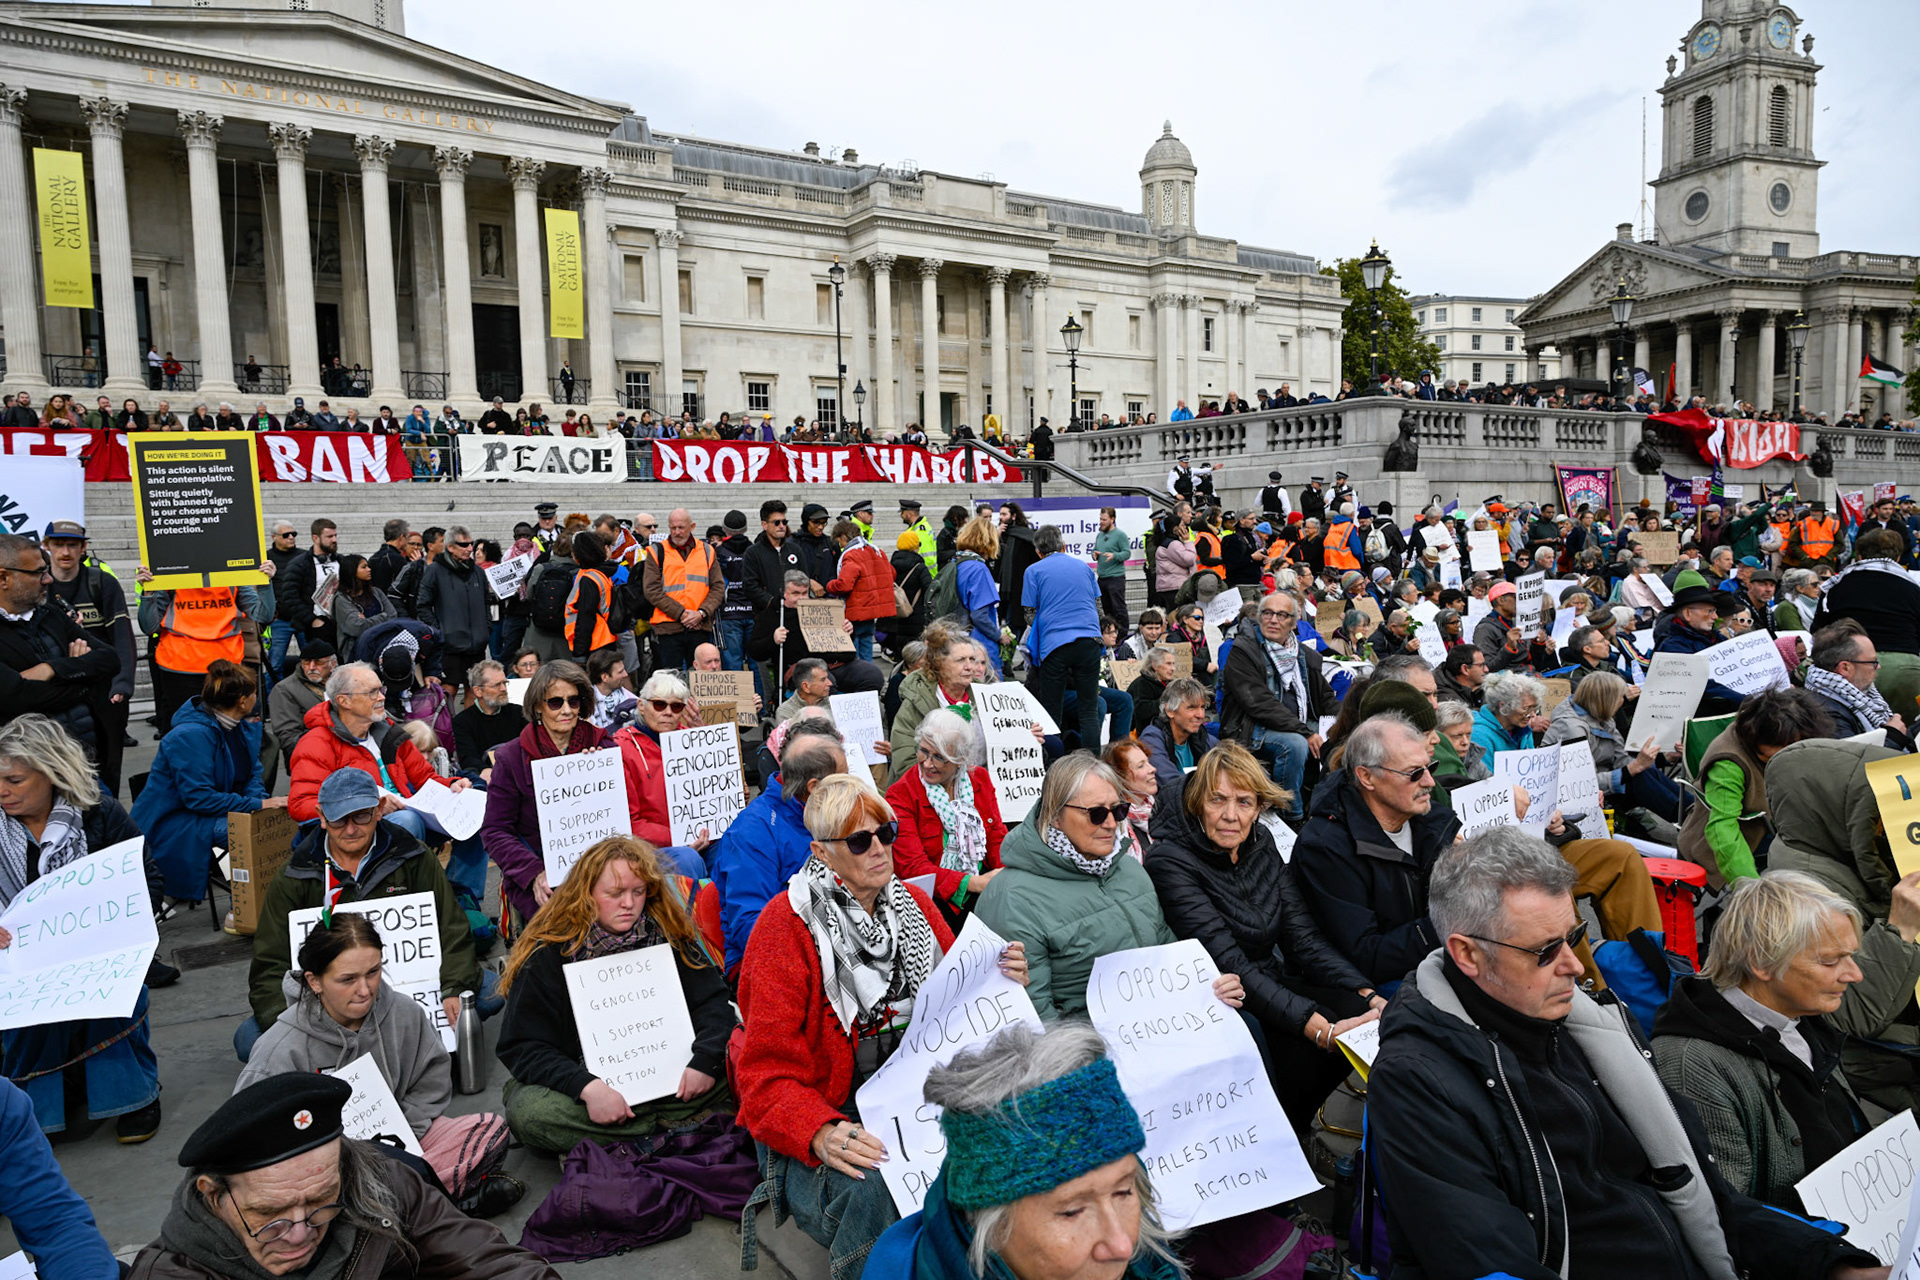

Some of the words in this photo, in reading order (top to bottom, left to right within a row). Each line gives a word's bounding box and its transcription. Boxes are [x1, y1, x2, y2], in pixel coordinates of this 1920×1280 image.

[142, 68, 200, 89] THE
[221, 79, 367, 114] NATIONAL
[384, 105, 495, 133] GALLERY
[49, 175, 65, 248] NATIONAL
[63, 176, 82, 249] GALLERY
[556, 231, 567, 290] NATIONAL
[565, 232, 578, 291] GALLERY
[146, 467, 166, 475] This
[168, 466, 196, 474] action
[209, 465, 234, 473] silent
[263, 435, 391, 483] BAN
[483, 442, 612, 474] PEACE
[654, 440, 770, 483] DROP
[779, 444, 850, 483] THE
[167, 475, 235, 484] contemplative.
[149, 490, 180, 498] Sitting
[181, 488, 213, 498] quietly
[150, 499, 171, 507] with
[173, 498, 207, 506] banned
[209, 497, 233, 505] signs
[164, 518, 200, 526] courage
[202, 515, 219, 523] and
[179, 507, 211, 515] chosen
[154, 526, 203, 536] protection.
[1519, 582, 1522, 590] I
[176, 597, 233, 610] WELFARE
[801, 617, 833, 626] GENOCIDE
[1719, 645, 1735, 661] Jew
[1736, 636, 1768, 650] Deplores
[1715, 662, 1738, 676] Gaza
[1740, 651, 1773, 666] Genocide
[694, 685, 739, 697] GENOCIDE
[695, 673, 698, 683] I
[701, 674, 736, 684] OPPOSE
[1727, 679, 1743, 689] and
[981, 692, 988, 712] I
[990, 694, 1029, 713] OPPOSE
[668, 736, 672, 752] I
[681, 726, 730, 750] OPPOSE
[540, 767, 545, 780] I
[554, 757, 614, 778] OPPOSE
[665, 746, 737, 777] GENOCIDE
[992, 747, 995, 765] I
[1002, 748, 1038, 762] SUPPORT
[1517, 751, 1558, 775] OPPOSE
[673, 784, 677, 802] I
[683, 769, 741, 800] SUPPORT
[997, 767, 1046, 781] PALESTINE
[540, 779, 616, 805] GENOCIDE
[1895, 775, 1912, 801] I
[1462, 803, 1467, 821] I
[1474, 789, 1509, 814] OPPOSE
[548, 819, 552, 833] I
[559, 808, 611, 831] SUPPORT
[228, 822, 238, 862] EWIS
[549, 827, 617, 851] PALESTINE
[27, 849, 139, 903] OPPOSE
[232, 881, 242, 923] JOHN
[7, 892, 142, 953] ENOCIDE
[366, 903, 433, 930] POSE
[11, 948, 150, 988] SUPPORT
[579, 974, 585, 988] I
[597, 959, 653, 983] OPPOSE
[0, 963, 144, 1000] ALESTINE
[1098, 972, 1107, 1013] I
[1117, 958, 1210, 1002] OPPOSE
[4, 986, 114, 1016] CTION
[590, 987, 656, 1011] GENOCIDE
[592, 1032, 598, 1047] I
[608, 1017, 664, 1041] SUPPORT
[1118, 1005, 1223, 1052] GENOCIDE
[599, 1040, 668, 1066] PALESTINE
[606, 1067, 656, 1087] ACTION
[345, 1099, 382, 1127] UPPORT
[1143, 1110, 1157, 1132] I
[1172, 1078, 1255, 1121] SUPPORT
[1144, 1125, 1259, 1180] PALESTINE
[1194, 1167, 1268, 1201] ACTION
